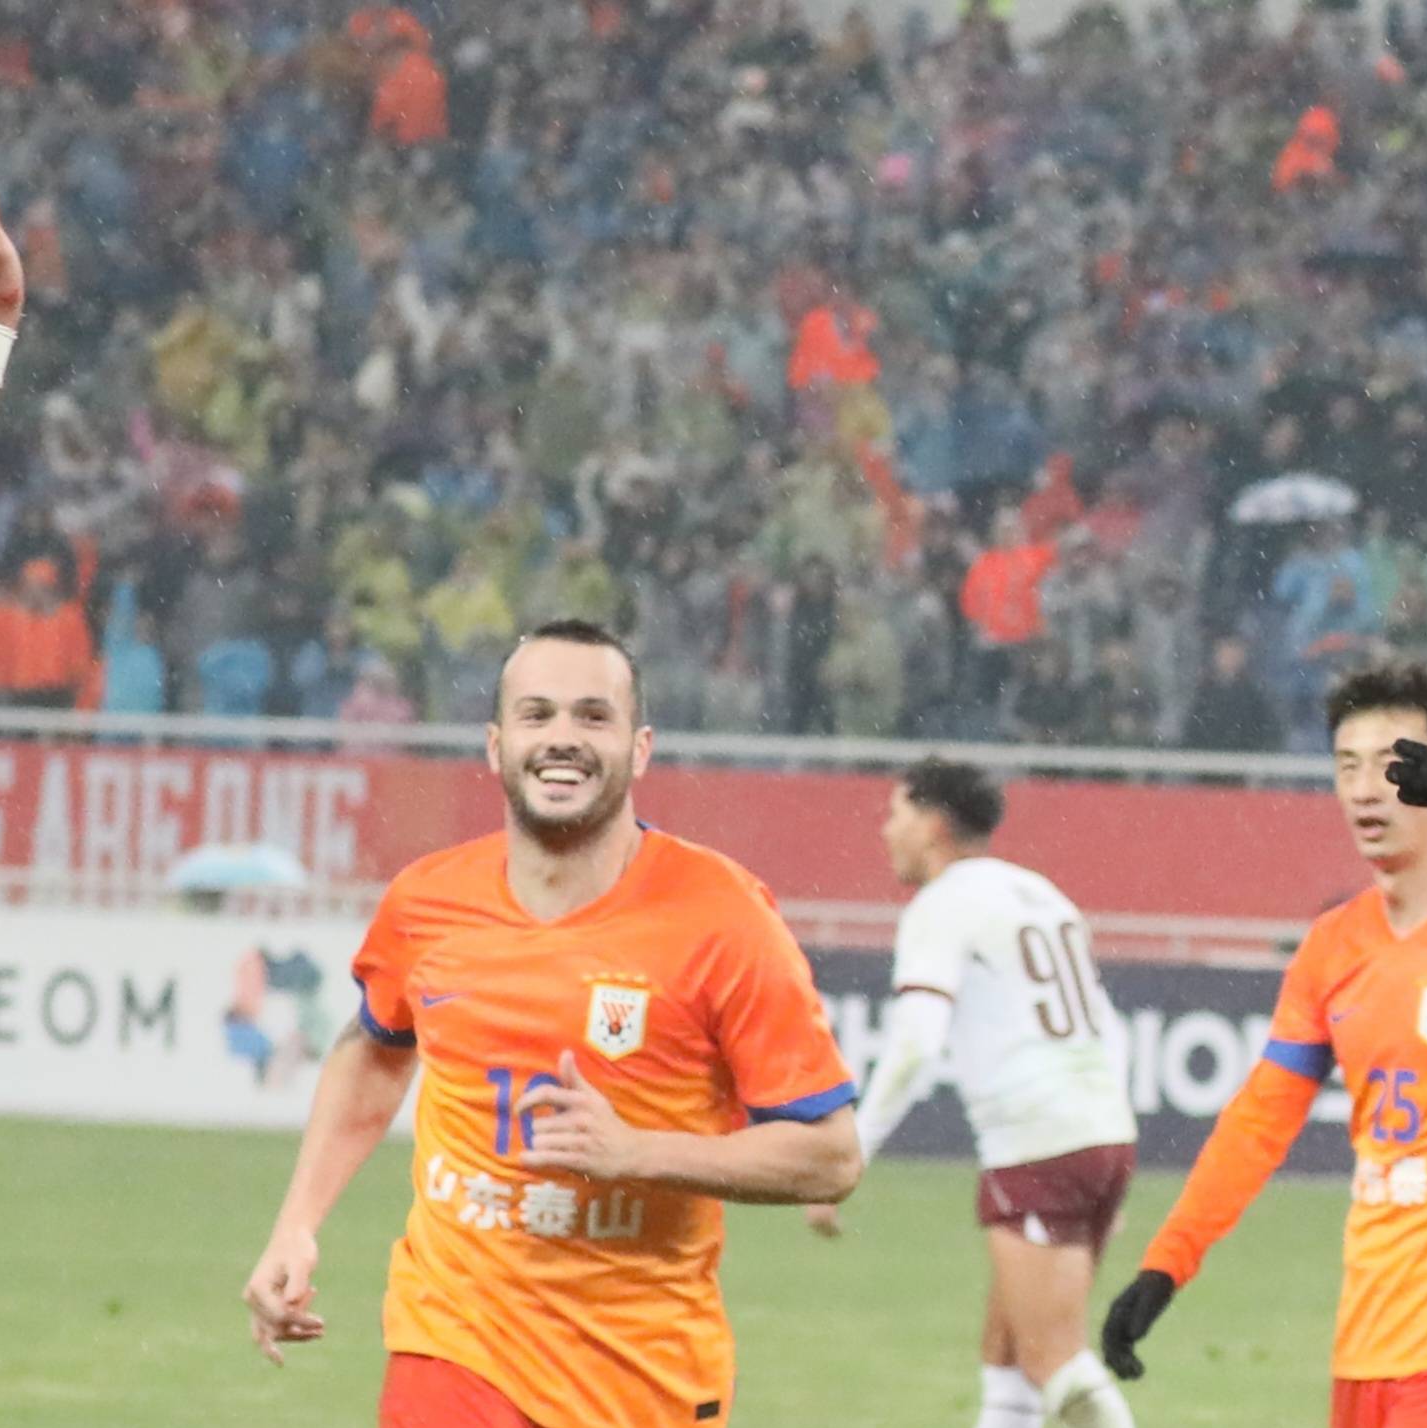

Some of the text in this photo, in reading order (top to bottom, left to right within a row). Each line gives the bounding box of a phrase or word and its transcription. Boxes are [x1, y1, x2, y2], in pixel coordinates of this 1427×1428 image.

[33, 752, 194, 906] ARE
[202, 757, 370, 916] ONE
[1367, 1067, 1421, 1142] 25
